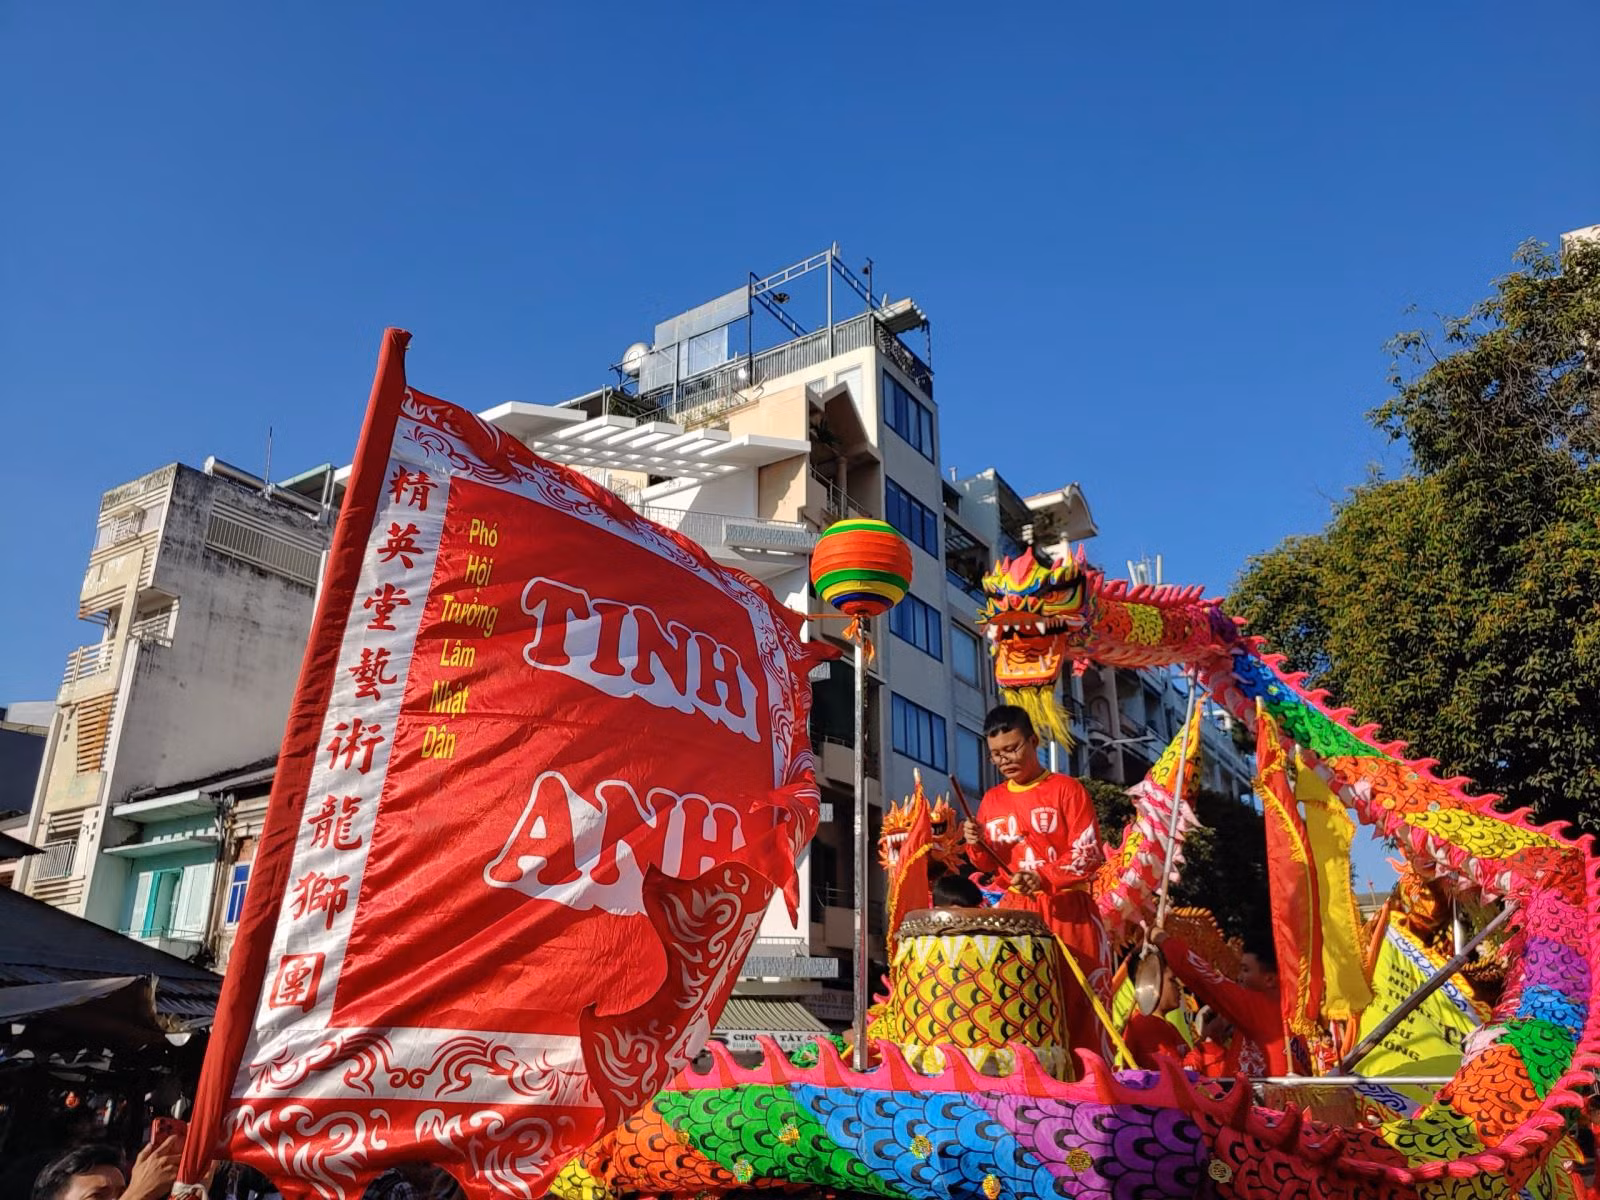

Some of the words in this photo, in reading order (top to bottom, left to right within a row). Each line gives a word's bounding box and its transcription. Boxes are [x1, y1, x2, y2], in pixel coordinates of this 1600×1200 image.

[469, 518, 498, 547] Phó
[464, 554, 493, 593] Hội
[441, 594, 498, 637] Trưởng
[440, 639, 476, 668] Lâm
[522, 577, 757, 732] TINH
[429, 680, 469, 719] Nhật
[269, 465, 438, 1013] 精英堂藝術龍獅團
[421, 724, 456, 759] Dân
